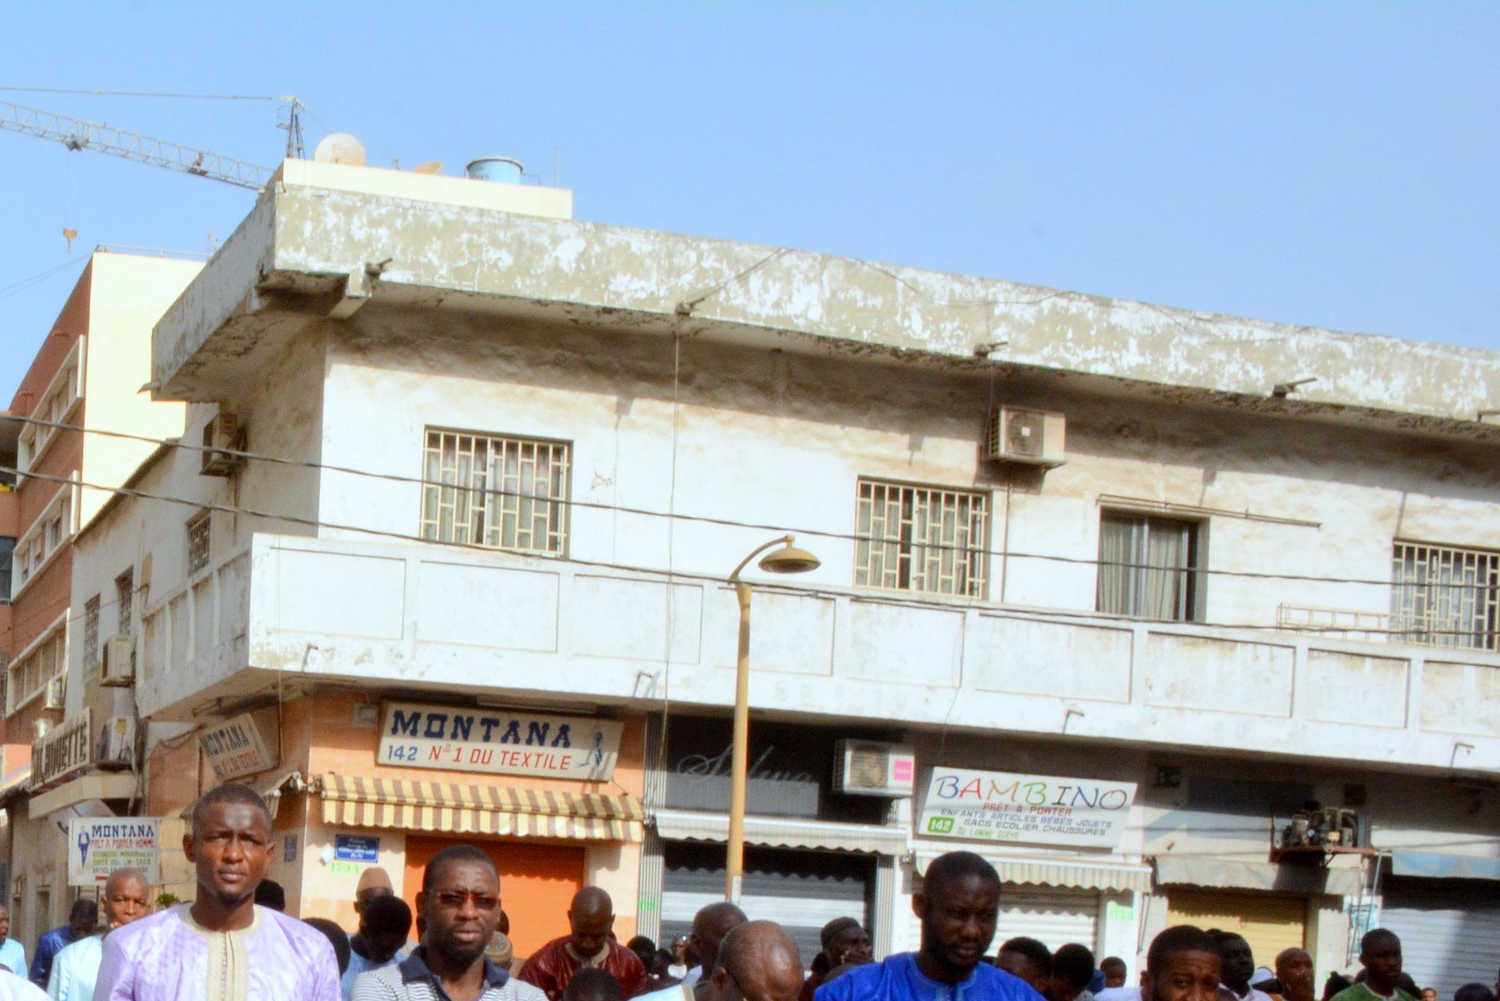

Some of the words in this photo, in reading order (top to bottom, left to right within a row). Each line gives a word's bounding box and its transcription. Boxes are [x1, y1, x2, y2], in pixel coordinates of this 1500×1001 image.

[391, 710, 571, 748] MONTANA
[388, 744, 418, 761] 142
[469, 748, 493, 764] DU
[500, 751, 572, 770] TEXTILE
[935, 775, 1128, 811] BAMBINO
[941, 808, 986, 819] ENFANTS
[990, 812, 1037, 824] ARTICLES
[1076, 818, 1113, 829] JOUETS
[1029, 805, 1072, 817] PORTER
[91, 824, 154, 838] MONTANA
[930, 818, 951, 832] 142
[964, 818, 992, 828] SACS
[1043, 824, 1107, 837] CHAUSSURES
